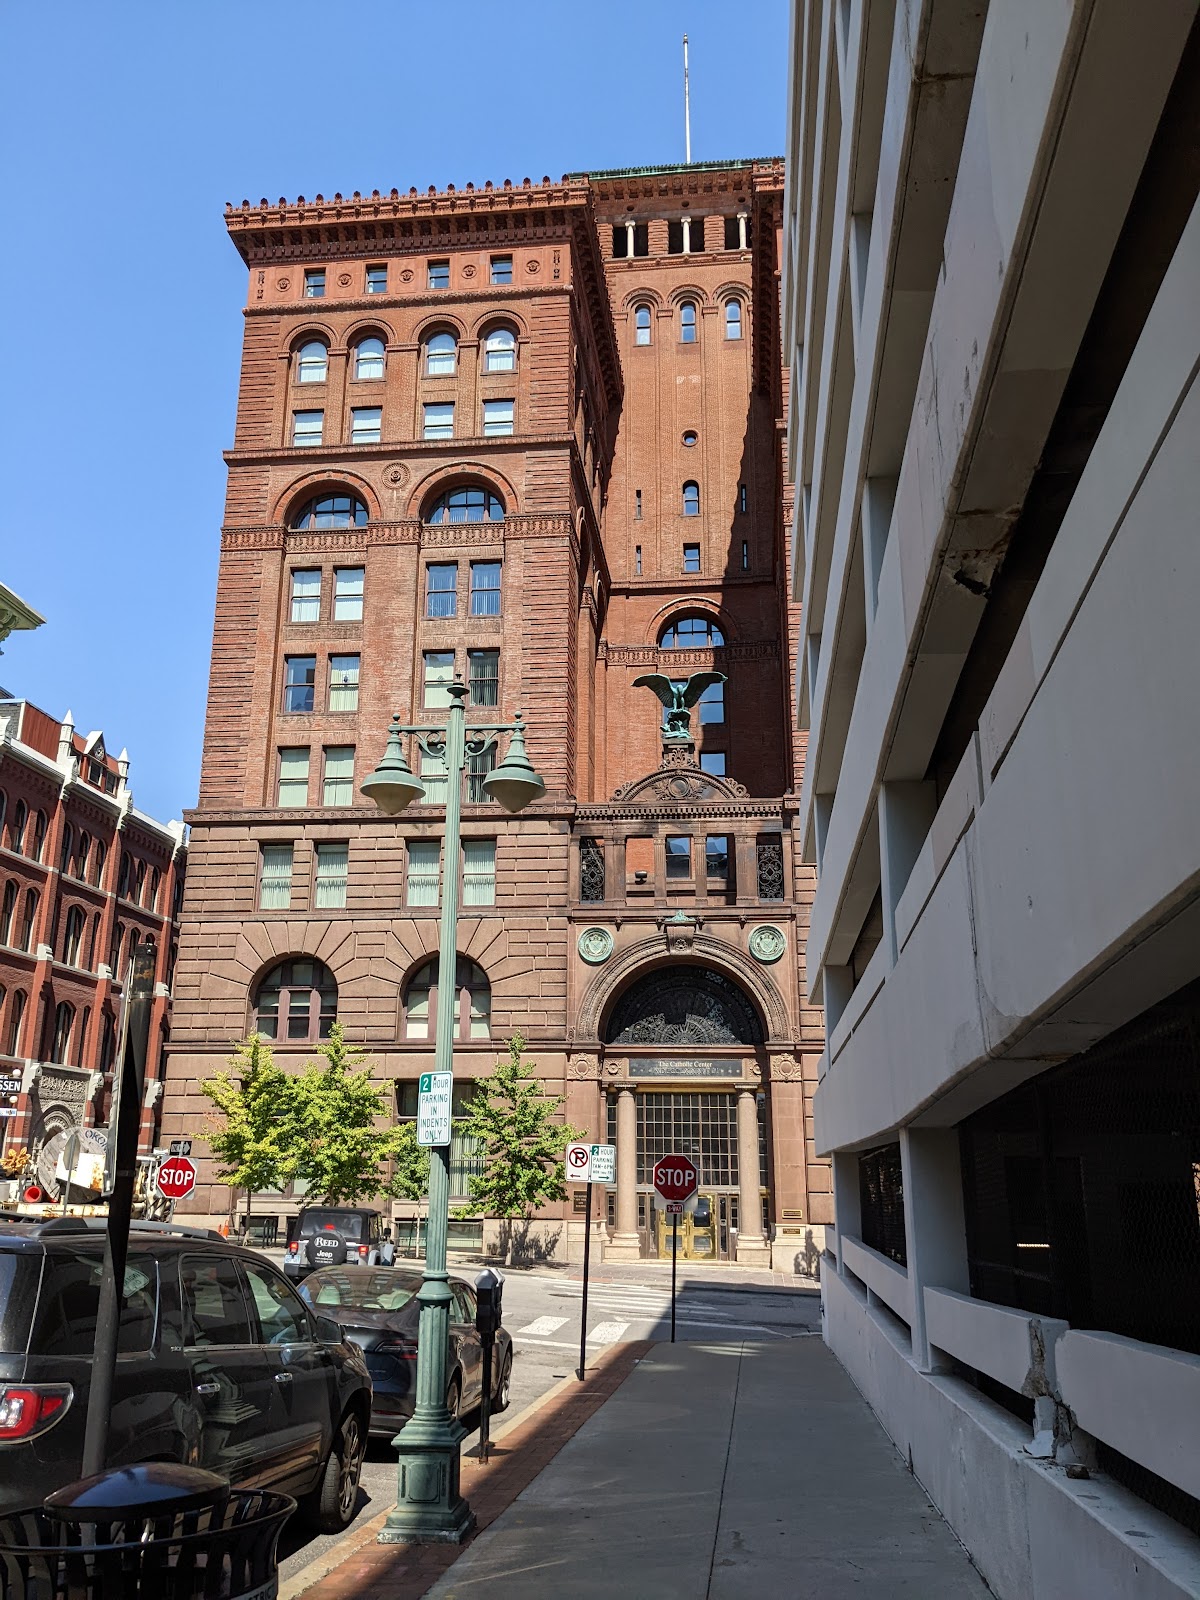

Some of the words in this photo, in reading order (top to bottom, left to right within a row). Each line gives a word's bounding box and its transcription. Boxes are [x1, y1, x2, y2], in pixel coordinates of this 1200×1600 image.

[422, 1077, 429, 1091] 2
[432, 1078, 449, 1089] HOUR
[421, 1094, 448, 1103] PARKING
[430, 1106, 437, 1115] IN
[420, 1118, 448, 1127] INDENTS
[425, 1130, 442, 1139] ONLY
[593, 1147, 599, 1156] 2
[160, 1168, 193, 1186] STOP
[656, 1168, 695, 1186] STOP
[314, 1236, 339, 1248] REED
[316, 1250, 333, 1258] Jeep
